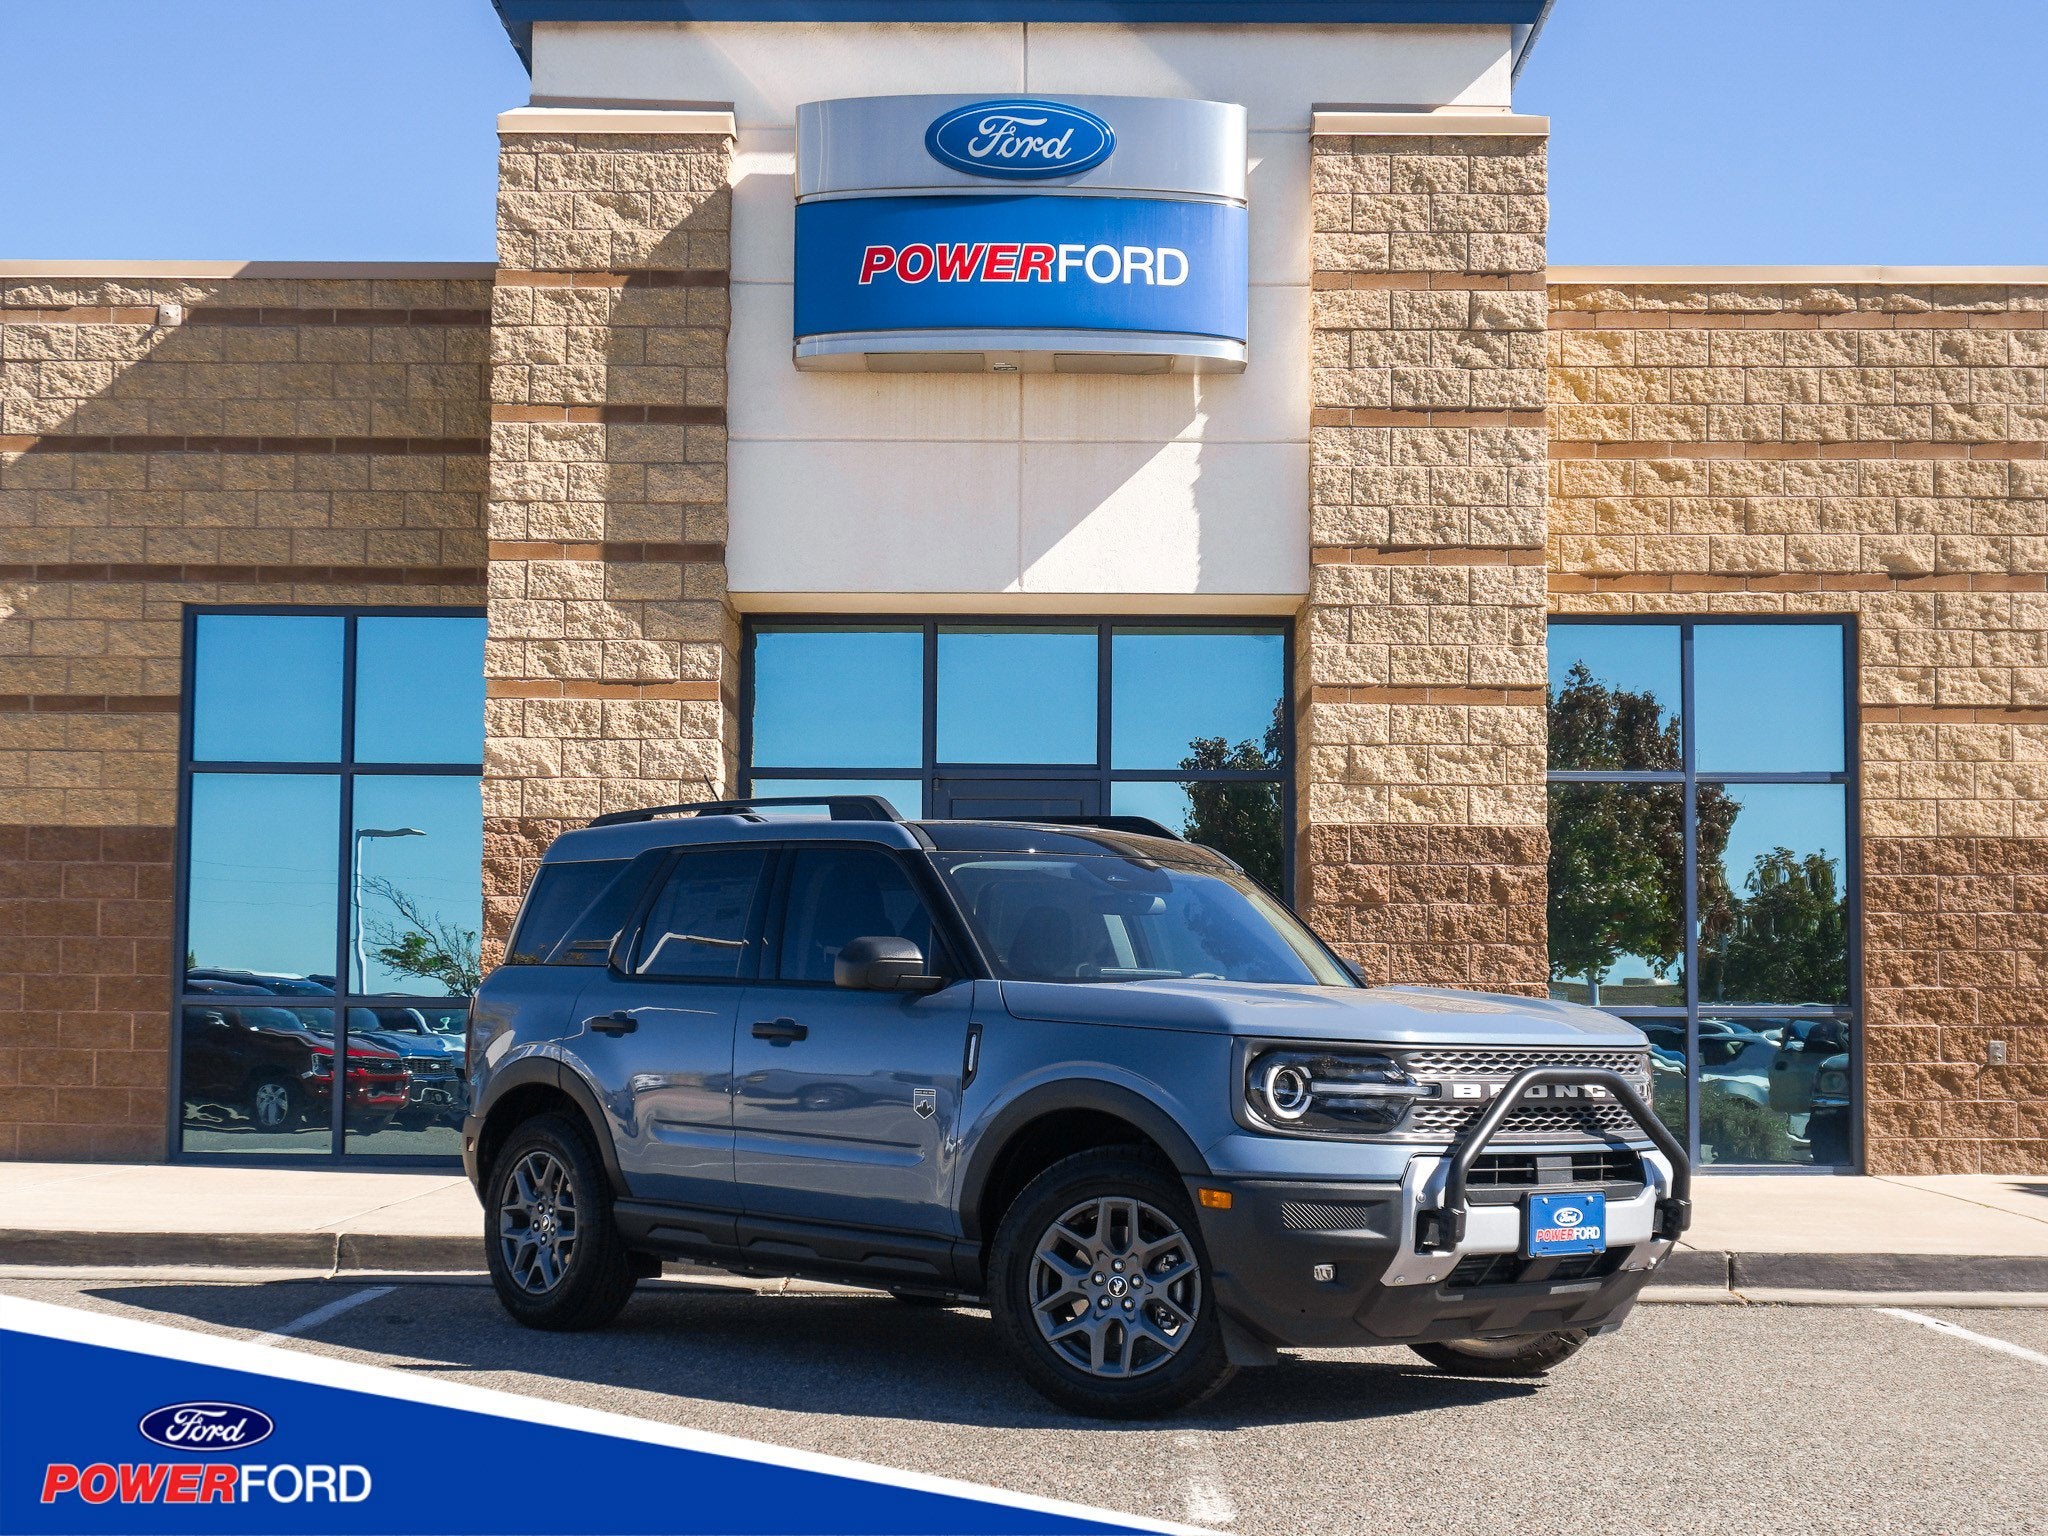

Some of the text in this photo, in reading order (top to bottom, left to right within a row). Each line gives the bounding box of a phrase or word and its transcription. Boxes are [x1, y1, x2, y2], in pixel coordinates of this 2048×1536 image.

[967, 115, 1074, 159] Ford
[858, 242, 1189, 287] POWERFORD
[1452, 1083, 1616, 1099] BONC
[1535, 1226, 1601, 1242] POWERFORD
